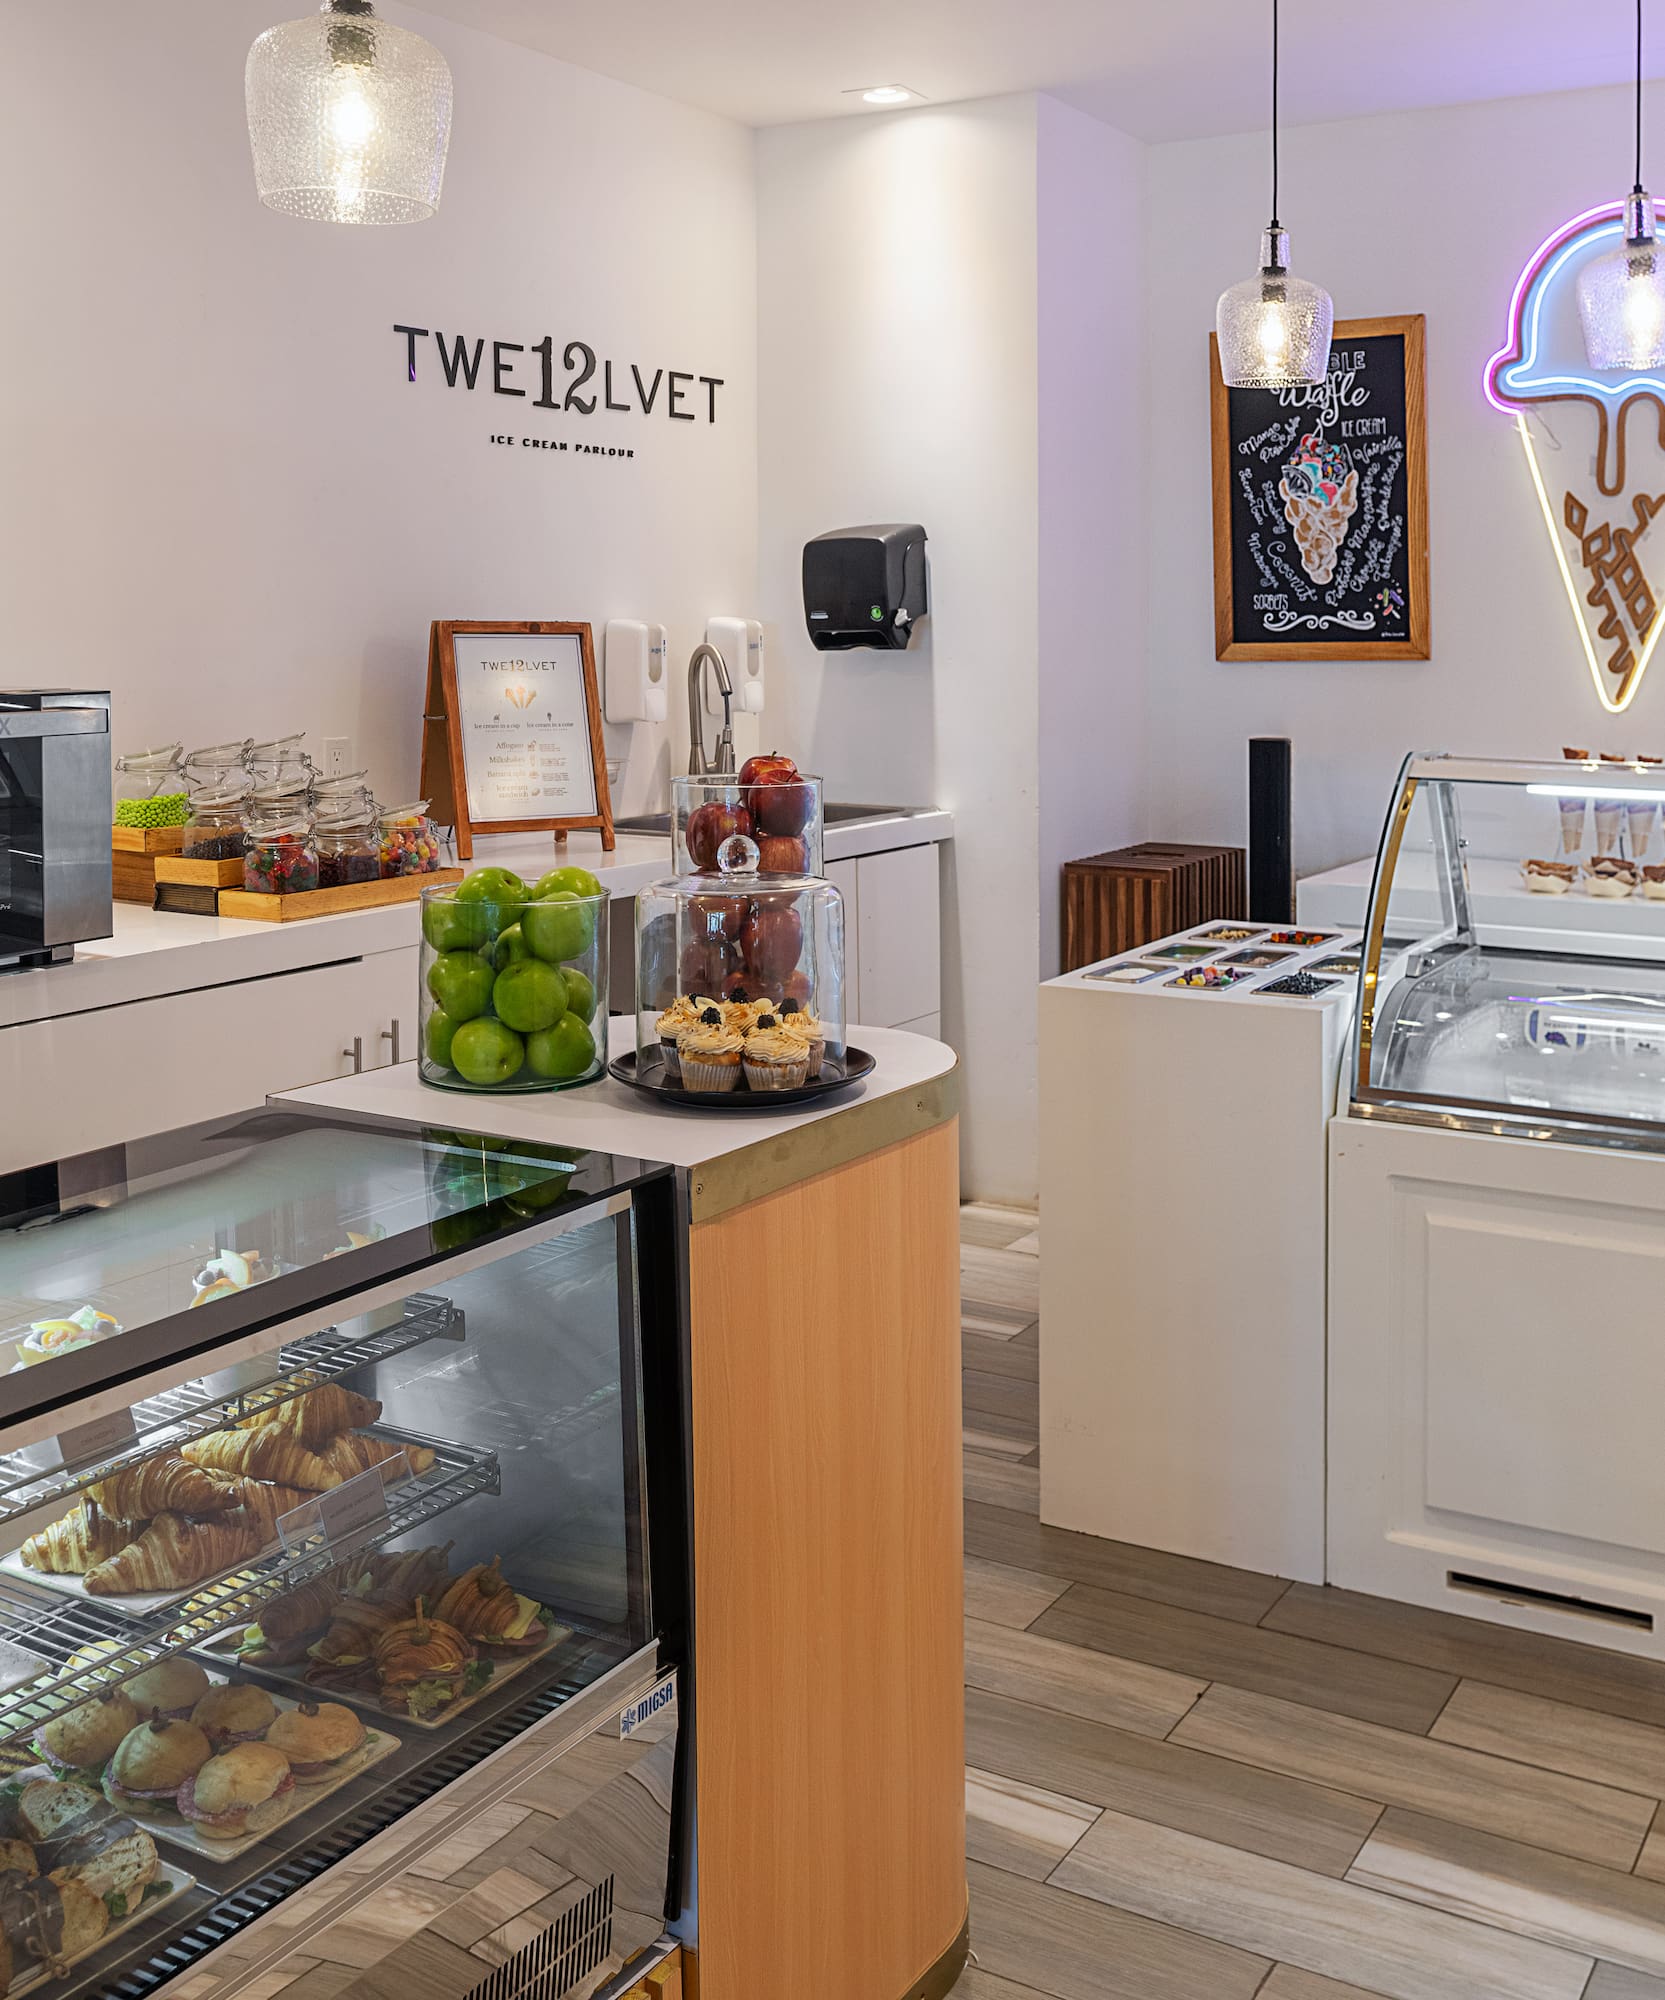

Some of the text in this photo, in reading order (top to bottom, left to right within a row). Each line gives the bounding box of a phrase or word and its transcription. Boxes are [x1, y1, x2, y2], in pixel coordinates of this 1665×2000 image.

[393, 324, 725, 424] TWE12LVET
[1270, 370, 1370, 427] Waffle
[1238, 422, 1281, 455] Mango
[1341, 417, 1386, 437] ICE CREAM
[490, 435, 634, 458] ICE CREAM PARLOUR
[1353, 435, 1403, 464] Vainilla
[1267, 540, 1318, 602] Coconut
[1253, 593, 1289, 611] SORBETS
[480, 659, 557, 672] TWE12LVET
[638, 1682, 673, 1722] MIGSA
